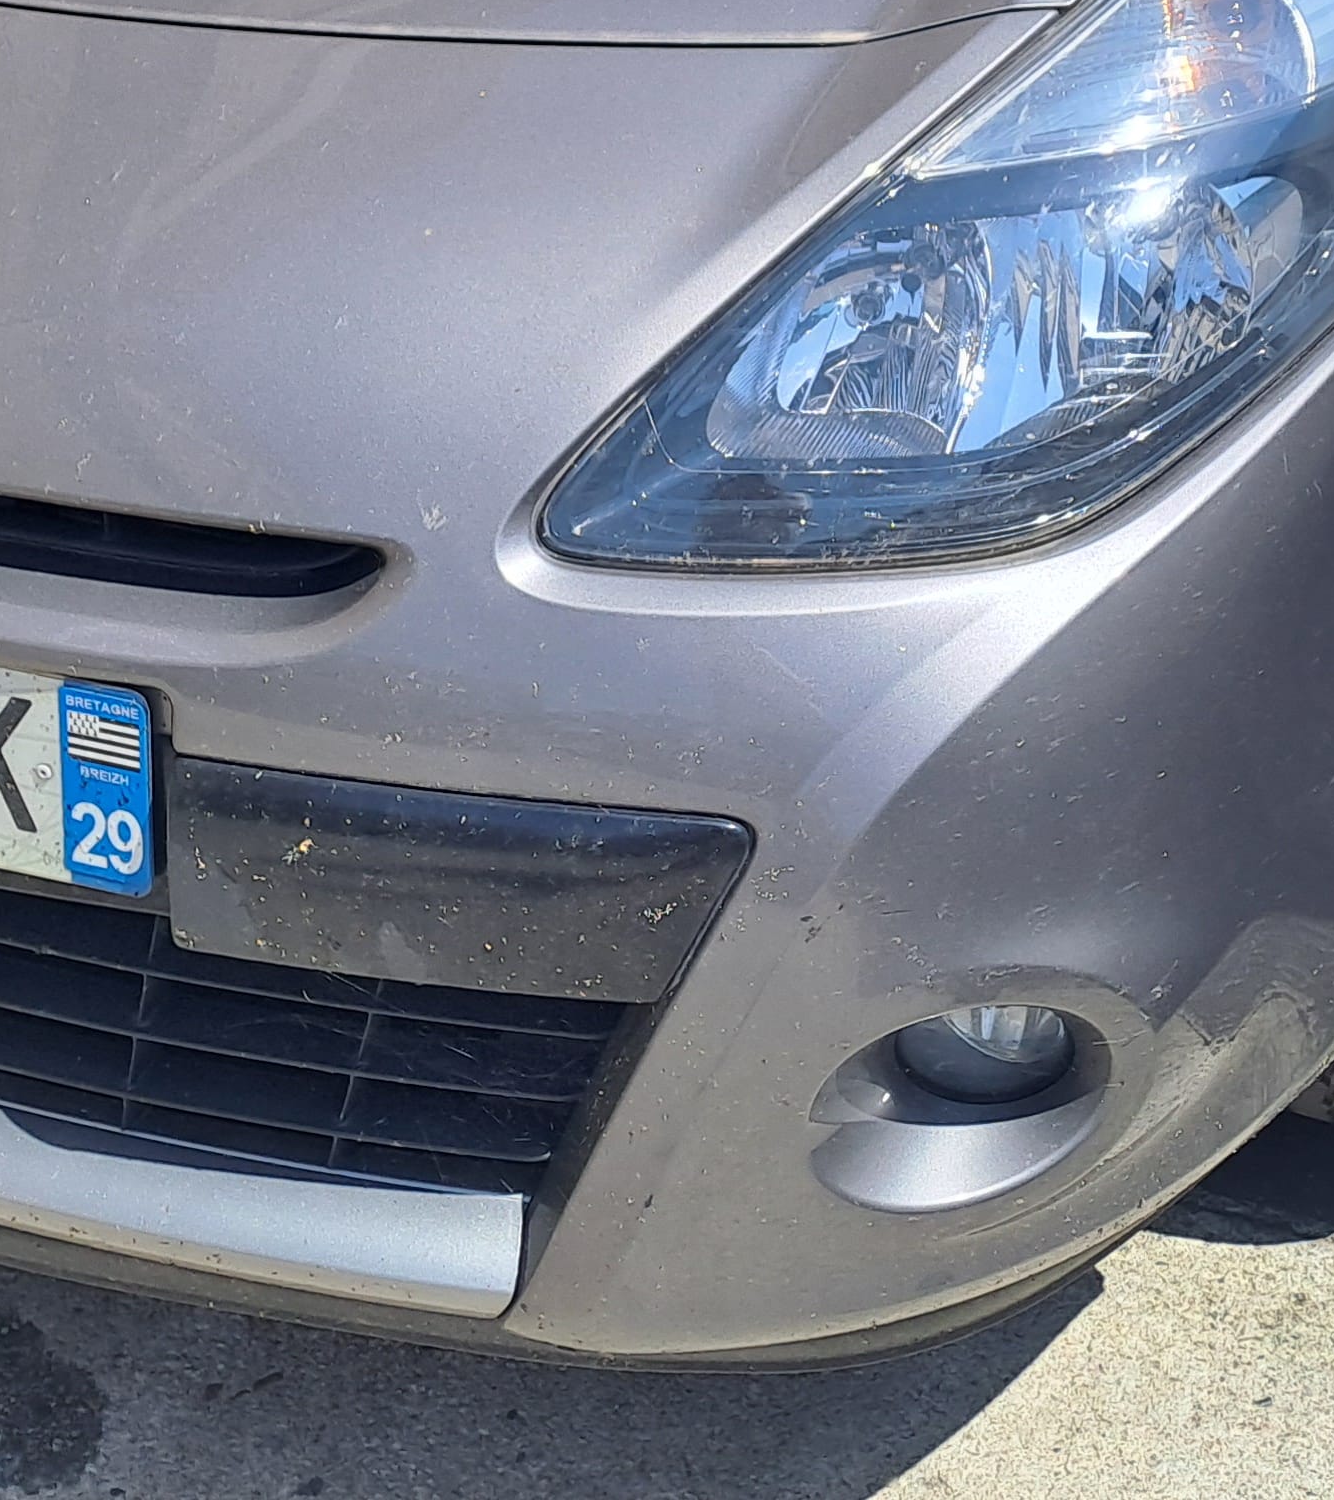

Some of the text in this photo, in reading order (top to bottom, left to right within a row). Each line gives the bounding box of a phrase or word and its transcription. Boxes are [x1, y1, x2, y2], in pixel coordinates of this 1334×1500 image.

[65, 694, 140, 720] BRETAGNE
[80, 764, 130, 786] BREIZH
[71, 801, 144, 875] 29
